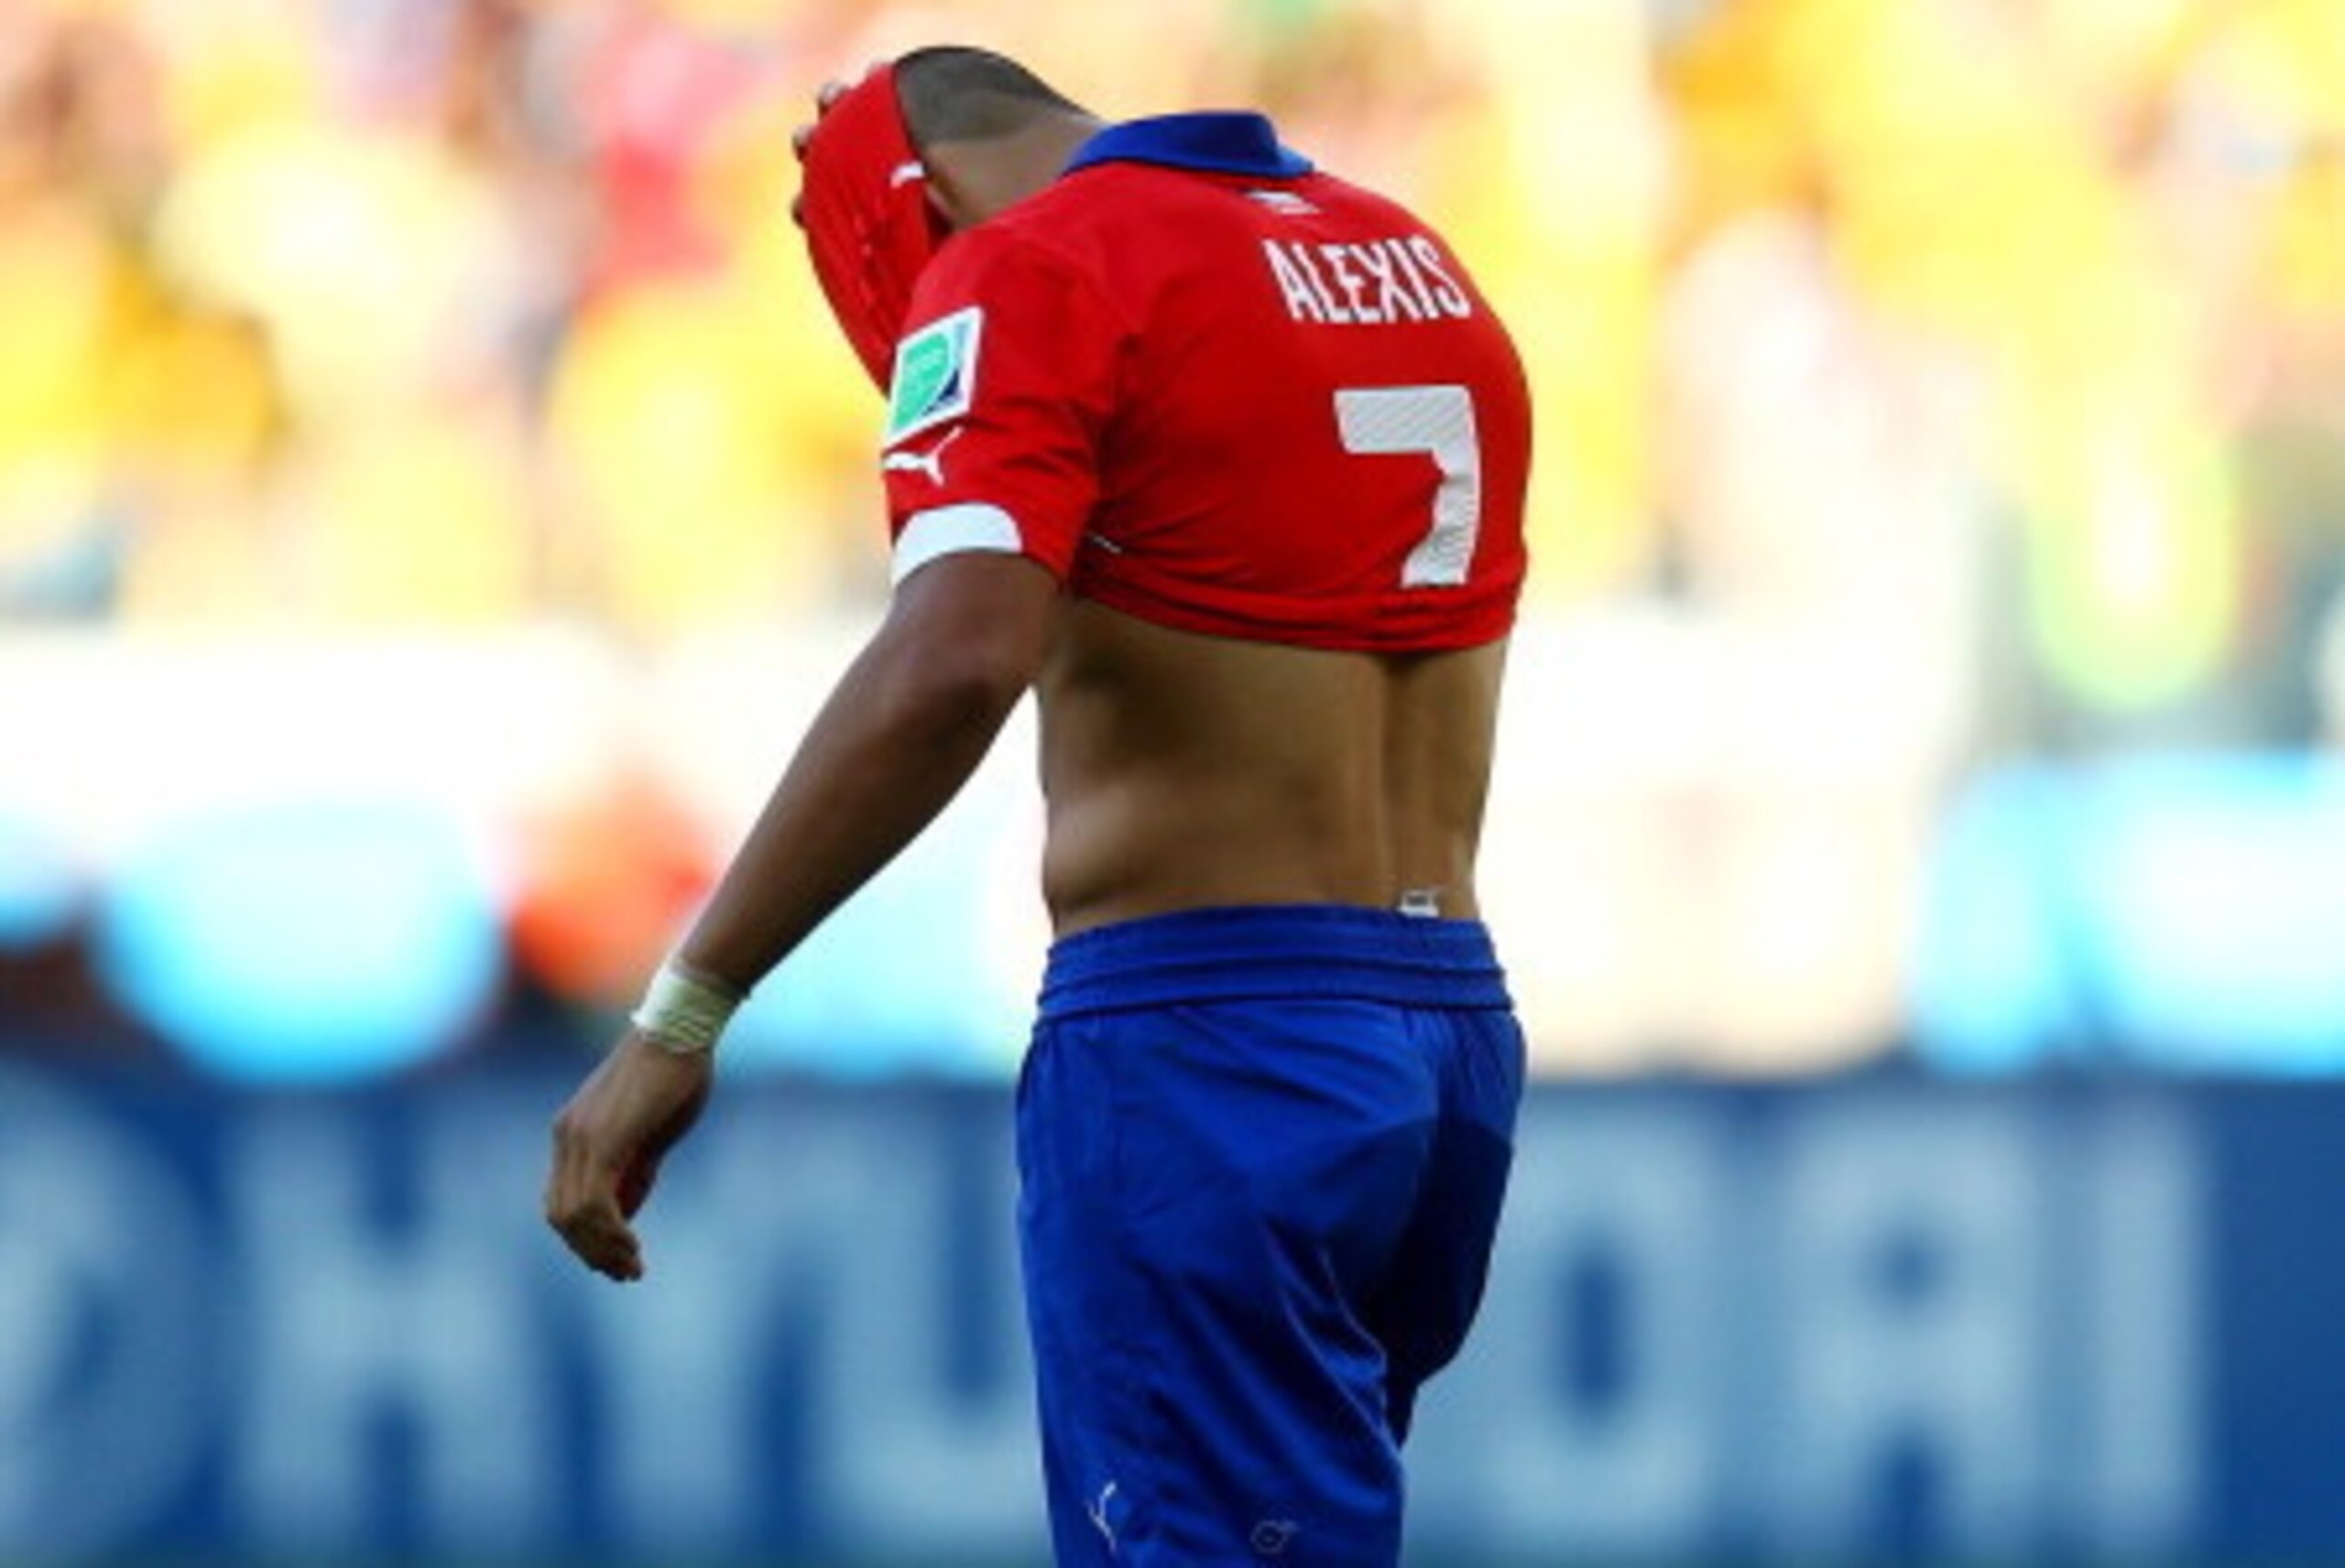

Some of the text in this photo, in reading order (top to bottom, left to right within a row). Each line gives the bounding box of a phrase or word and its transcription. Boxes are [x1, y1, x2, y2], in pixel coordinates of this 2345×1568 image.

[1263, 235, 1470, 322] ALEXIS
[1334, 385, 1480, 587] 7
[236, 1099, 2204, 1555] HYUDAI
